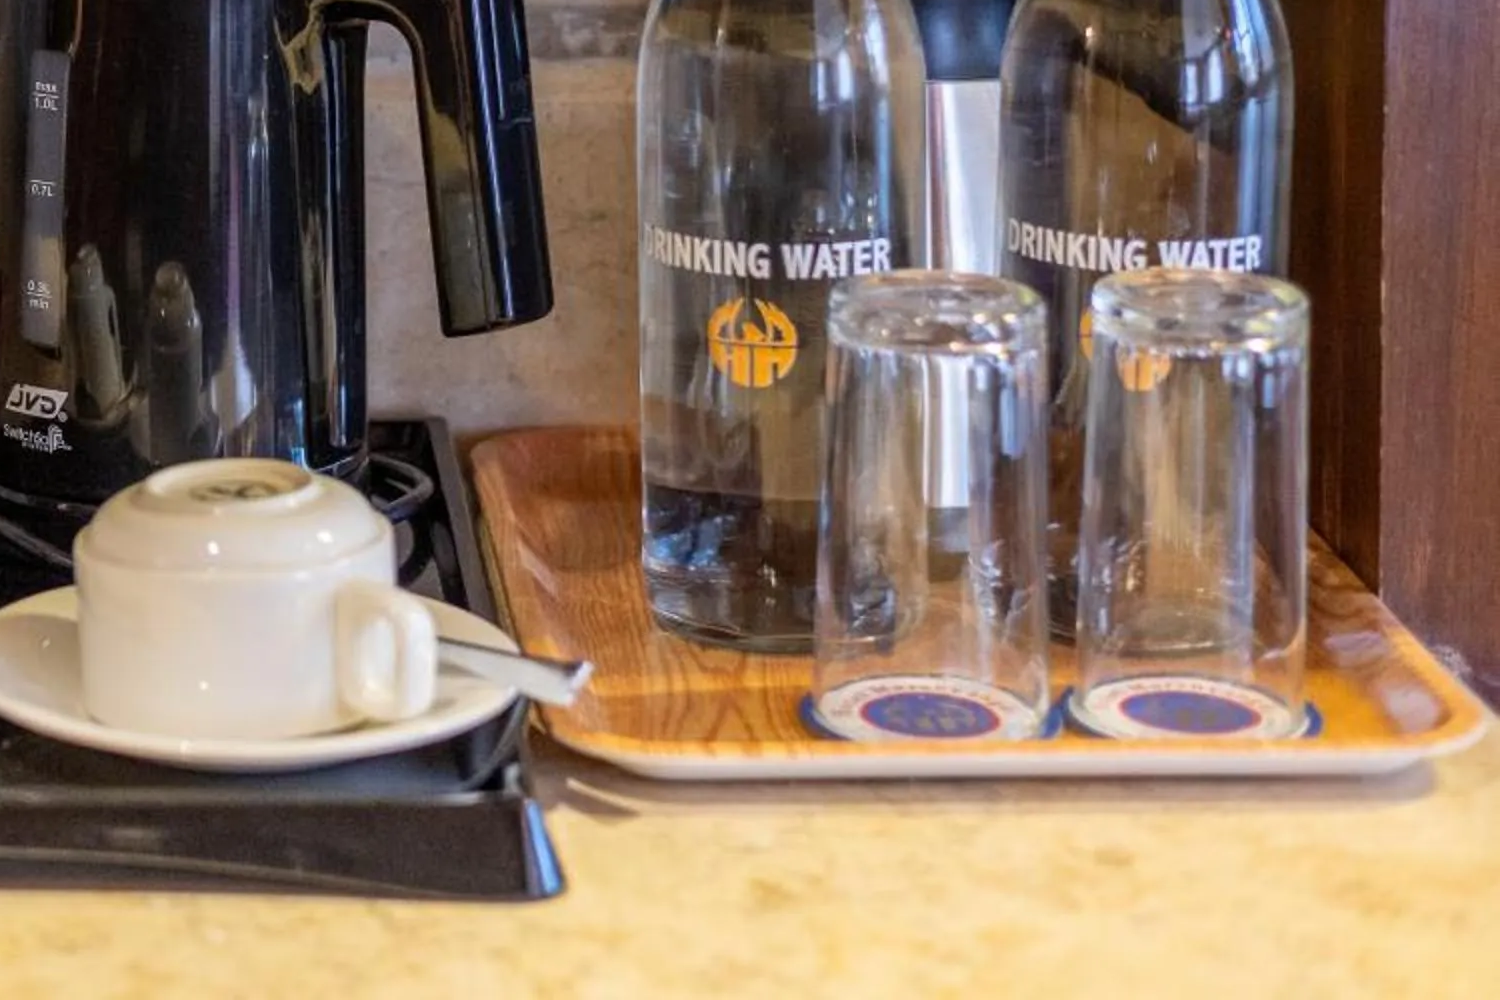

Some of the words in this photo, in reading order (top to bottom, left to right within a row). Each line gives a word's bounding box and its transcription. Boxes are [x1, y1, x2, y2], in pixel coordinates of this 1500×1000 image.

[31, 183, 53, 197] 0.7L
[643, 224, 771, 279] DRINKING
[781, 238, 892, 280] WATER
[1007, 217, 1149, 272] DRINKING
[1157, 235, 1262, 271] WATER
